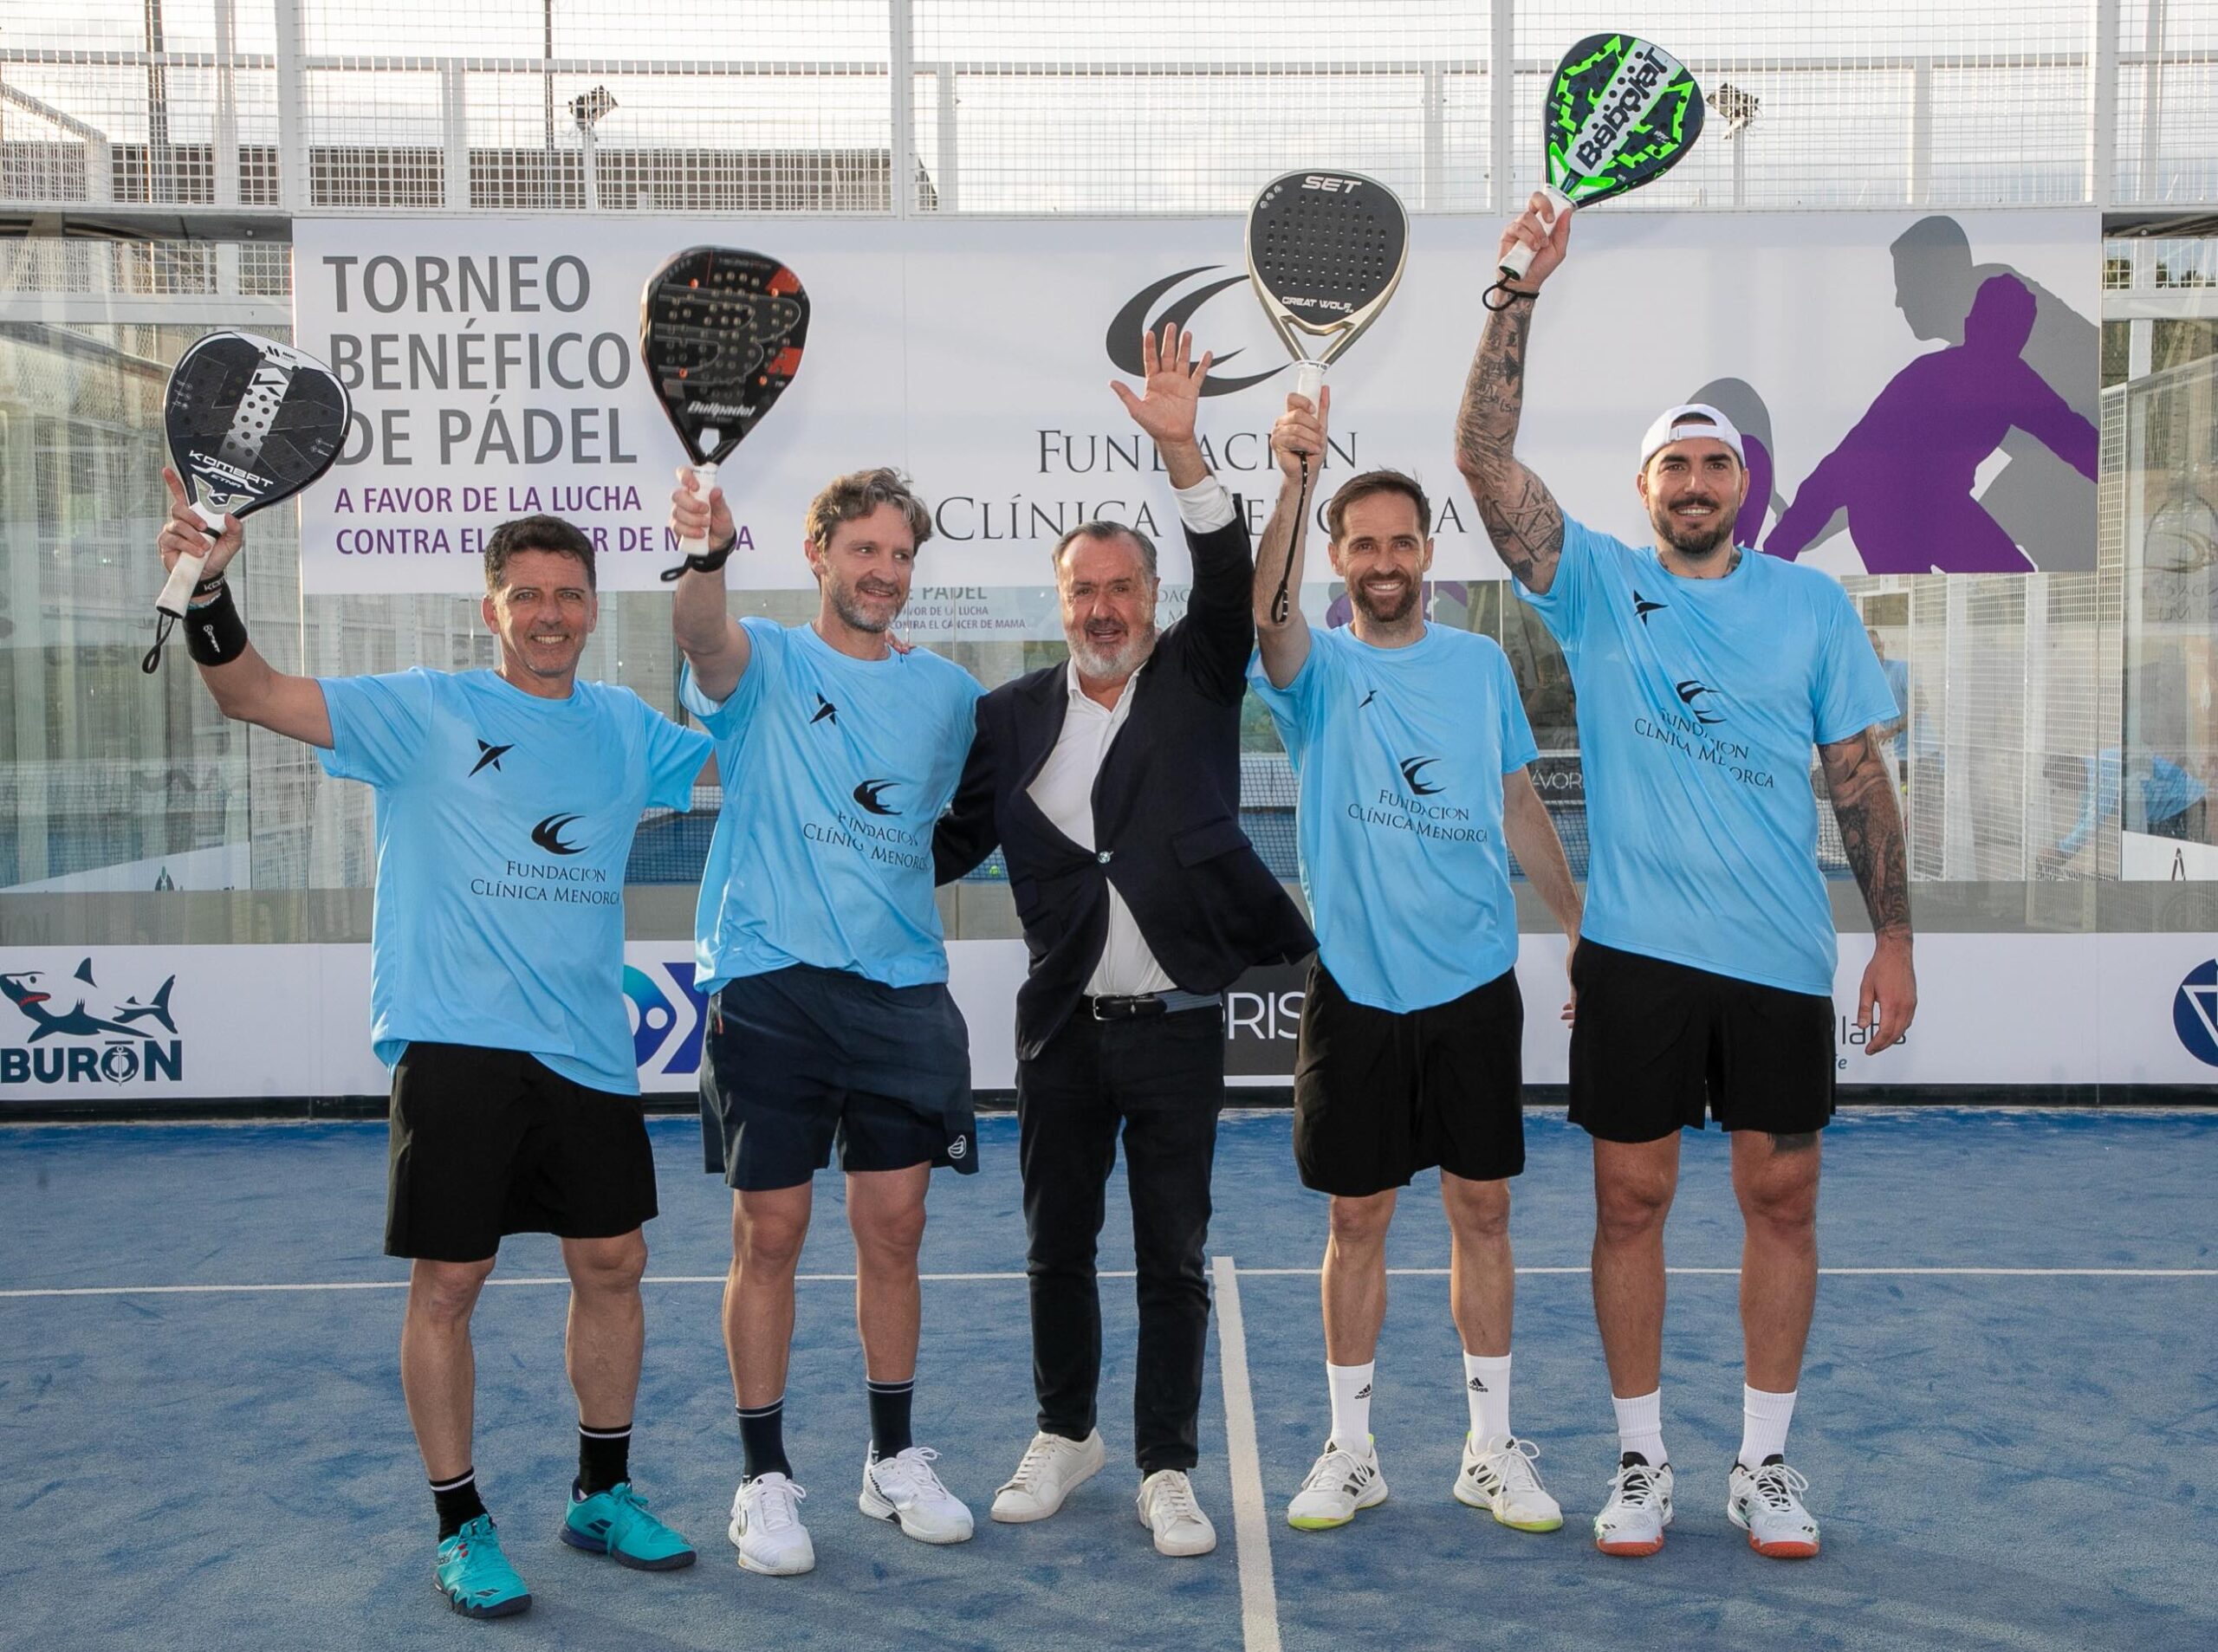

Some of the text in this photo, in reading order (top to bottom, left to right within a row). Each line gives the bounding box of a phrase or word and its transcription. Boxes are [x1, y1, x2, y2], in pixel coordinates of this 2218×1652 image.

[1300, 175, 1363, 194] SET
[322, 255, 591, 314] TORNEO
[1281, 296, 1317, 308] GREAT
[1319, 300, 1352, 311] WOLF
[328, 318, 632, 391] BENÉFICO
[334, 394, 638, 466] DE PÁDEL
[189, 450, 274, 487] KOMBAT
[211, 474, 243, 489] ETNA
[334, 485, 642, 514] A FAVOR DE LA LUCHA
[336, 528, 451, 554] CONTRA
[461, 528, 486, 554] EL
[619, 526, 654, 552] DE
[665, 525, 755, 552] MA
[929, 619, 939, 630] EL
[980, 619, 993, 629] DE
[996, 619, 1027, 629] MAMA
[958, 606, 989, 616] LUCHA
[1347, 803, 1414, 831] CLÍNICA
[803, 823, 866, 852] CLÍNIC
[470, 878, 548, 901] CLÍNICA
[1222, 991, 1307, 1040] RIS
